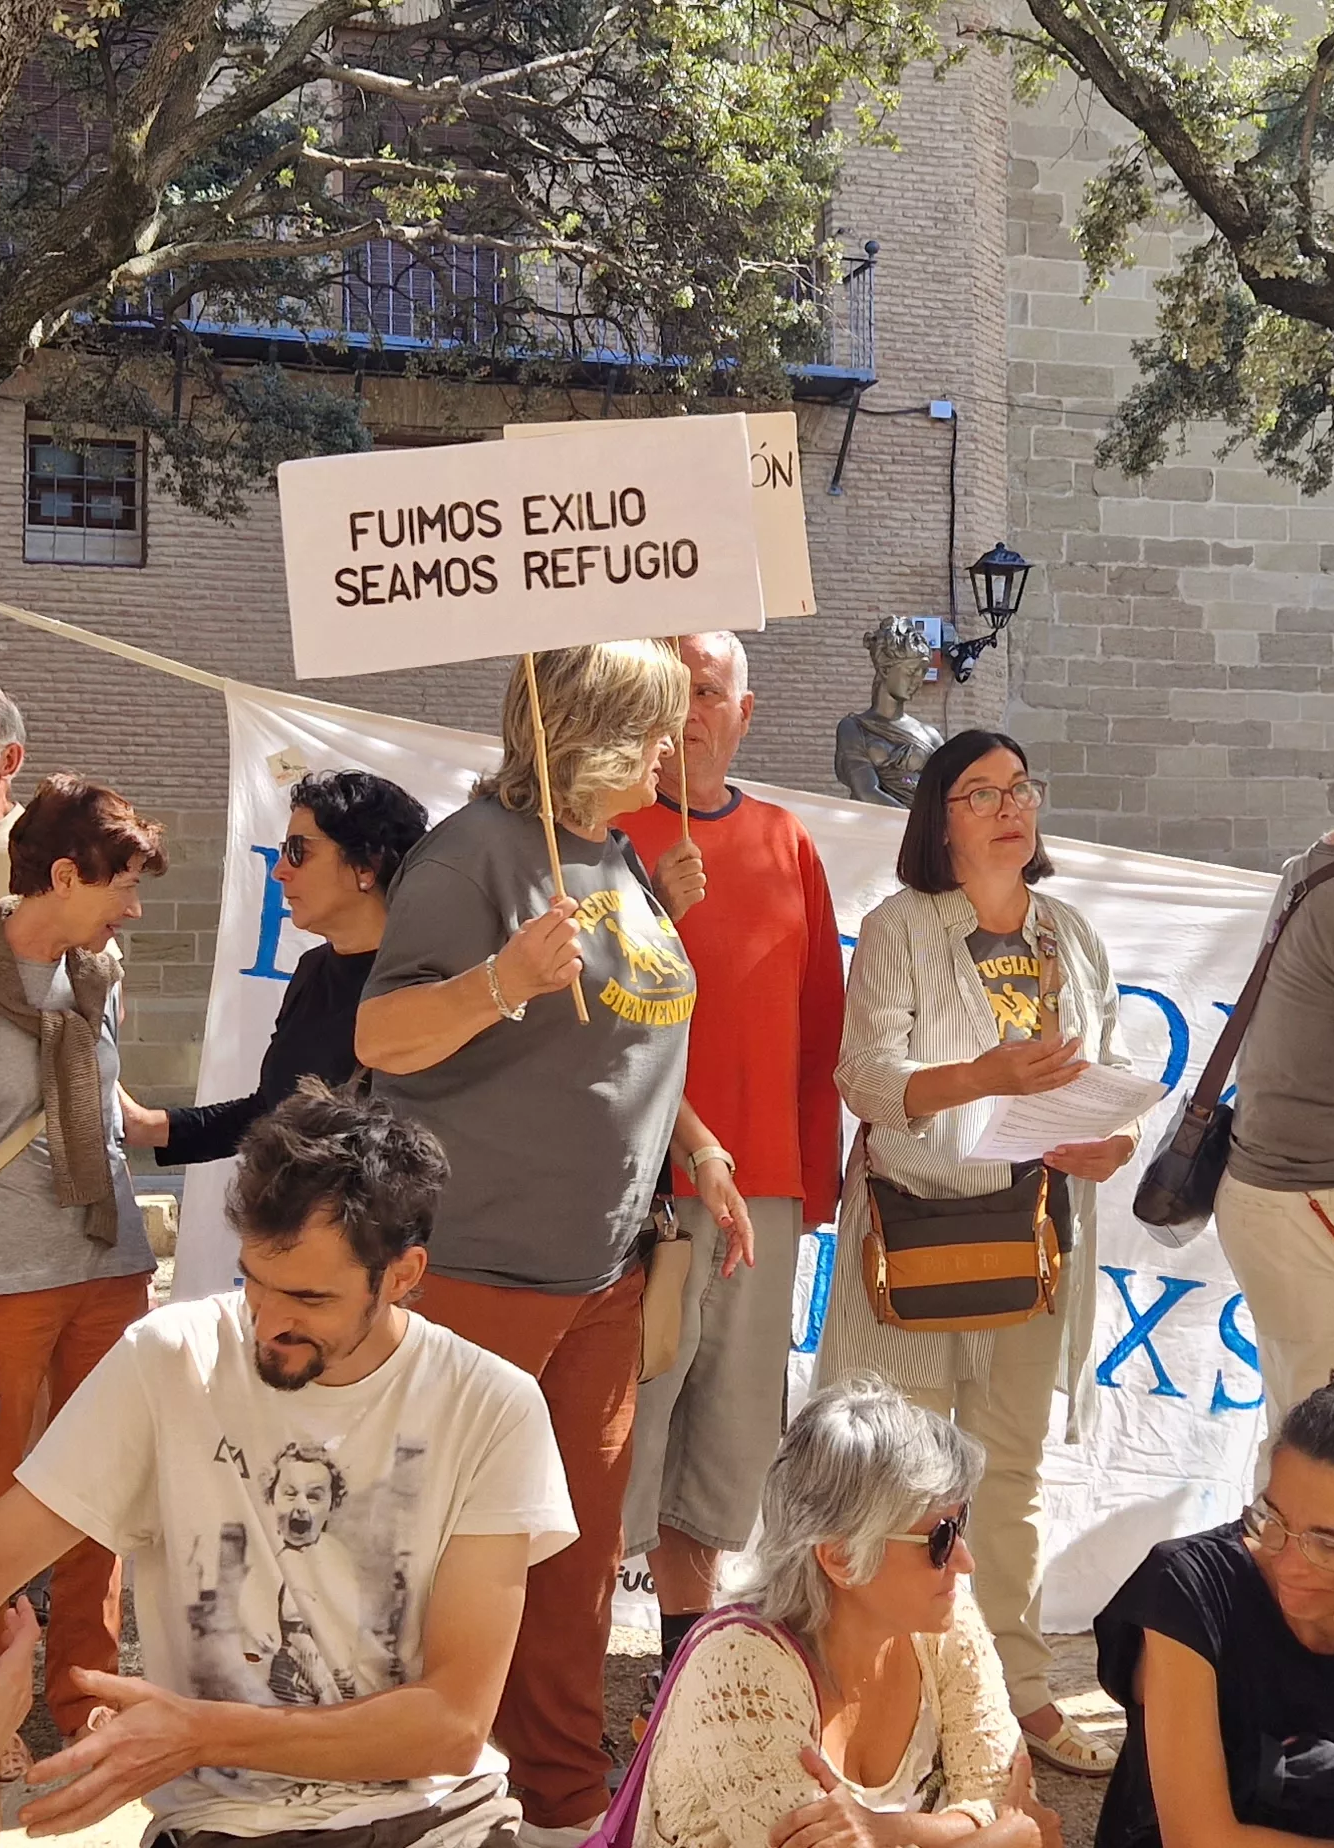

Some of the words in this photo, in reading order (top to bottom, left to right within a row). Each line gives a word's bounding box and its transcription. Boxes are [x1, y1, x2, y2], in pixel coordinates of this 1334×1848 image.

[348, 498, 503, 552] FUIMOS
[522, 486, 647, 537] EXILIO
[334, 554, 499, 608] SEAMOS
[523, 537, 700, 591] REFUGIO
